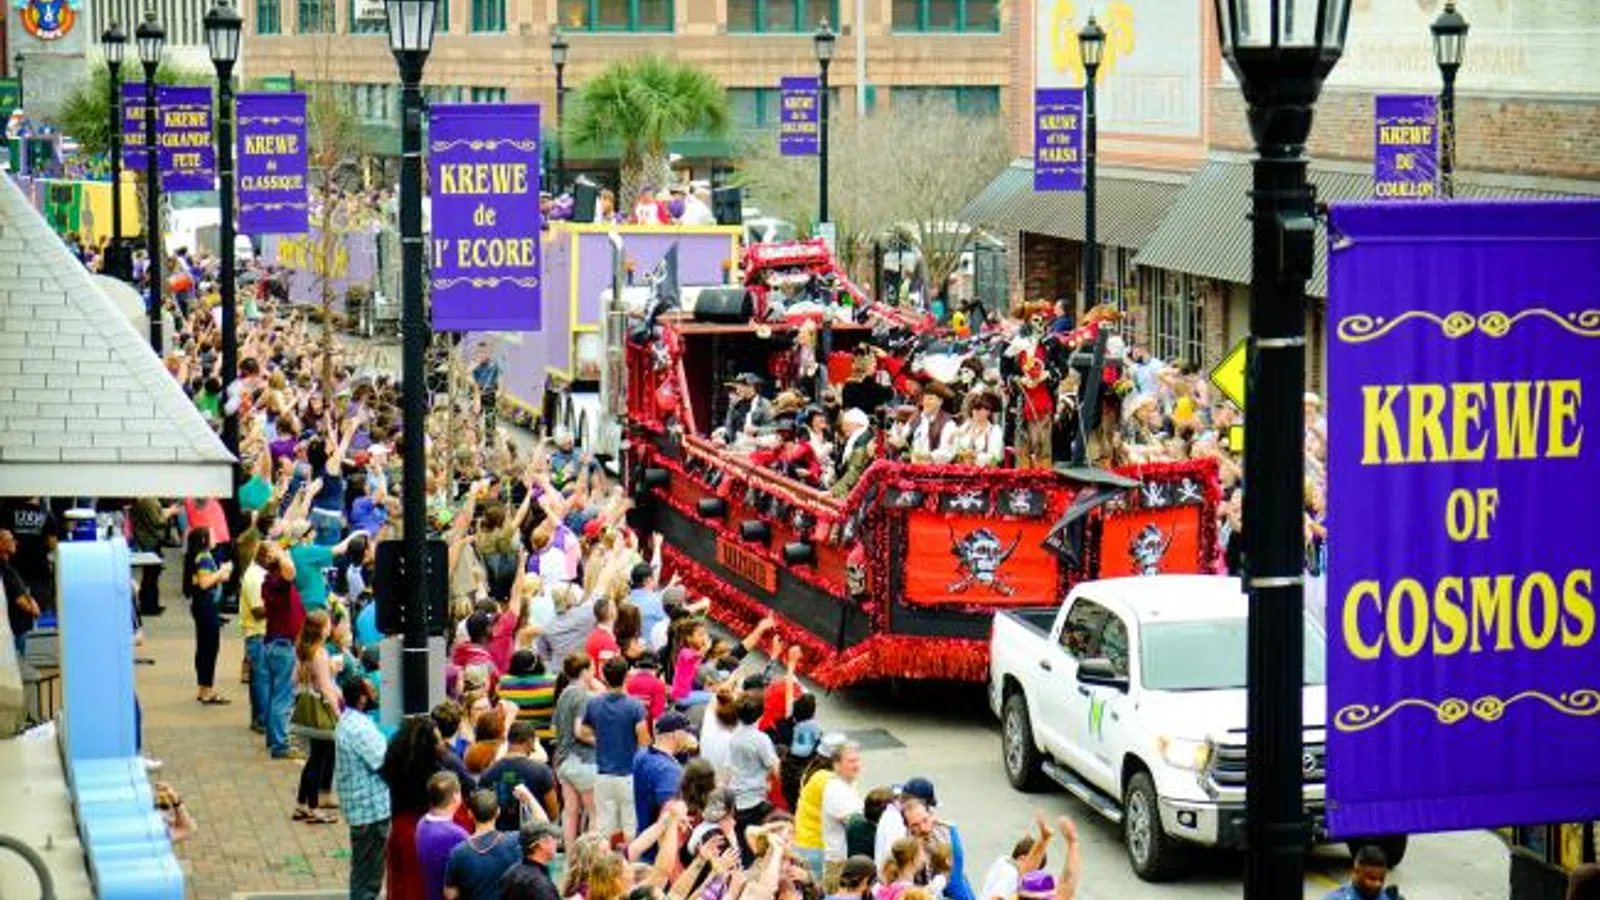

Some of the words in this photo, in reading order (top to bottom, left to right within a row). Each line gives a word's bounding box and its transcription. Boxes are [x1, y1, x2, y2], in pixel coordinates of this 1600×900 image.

[164, 111, 208, 128] KREWE
[1039, 115, 1077, 130] KREWE
[245, 134, 299, 155] KREWE
[1380, 126, 1431, 145] KREWE
[241, 175, 304, 191] CLASSIQUE
[440, 163, 528, 194] KREWE
[473, 203, 496, 226] de
[457, 238, 535, 268] ECORE
[1361, 379, 1583, 465] KREWE
[1445, 488, 1499, 542] OF
[1342, 569, 1596, 660] COSMOS
